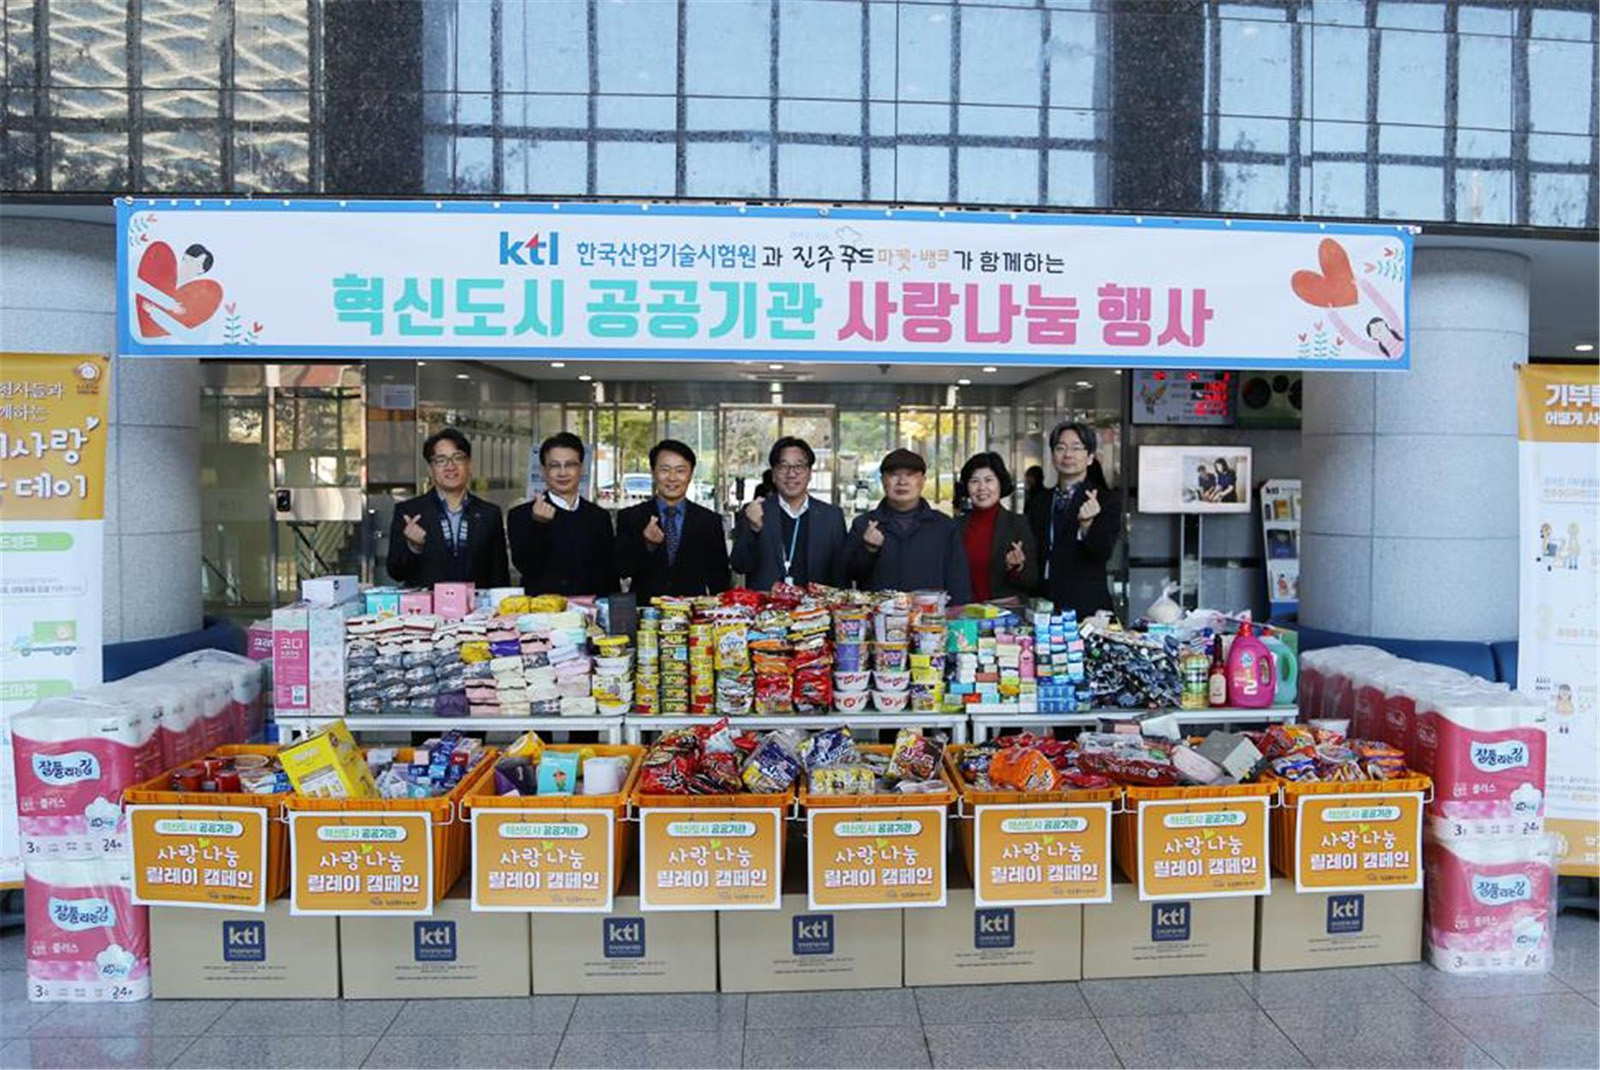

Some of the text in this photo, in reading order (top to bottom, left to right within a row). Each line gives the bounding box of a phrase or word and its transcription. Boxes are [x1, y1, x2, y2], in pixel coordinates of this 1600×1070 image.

[499, 231, 558, 265] ktl
[577, 242, 757, 268] 한국산업기술시험원
[762, 246, 783, 267] 과
[954, 251, 973, 271] 가
[980, 251, 1065, 273] 함께하는
[332, 273, 1214, 348] 혁신도시 공공기관 사랑나눔 행사
[15, 473, 87, 498] 데이
[1164, 836, 1203, 856] 사랑
[1321, 830, 1359, 850] 사랑
[158, 844, 198, 864] 사랑
[320, 851, 362, 870] 사랑
[500, 848, 542, 868] 사랑
[669, 847, 710, 867] 사랑
[836, 846, 876, 864] 사랑
[1002, 842, 1043, 861] 사랑
[1310, 851, 1409, 870] 릴레이 캠페인
[991, 864, 1098, 884] 릴레이 캠페인
[1154, 856, 1257, 877] 릴레이 캠페인
[146, 866, 253, 888] 릴레이 캠페인
[308, 874, 420, 893] 릴레이 캠페인
[489, 871, 600, 890] 릴레이 캠페인
[657, 870, 767, 889] 릴레이 캠페인
[824, 868, 933, 888] 릴레이 캠페인
[1157, 908, 1185, 926] ktl
[1332, 899, 1359, 918] ktl
[609, 924, 639, 942] ktl
[798, 921, 829, 939] ktl
[980, 914, 1009, 933] ktl
[229, 927, 259, 945] ktl
[420, 926, 450, 945] ktl
